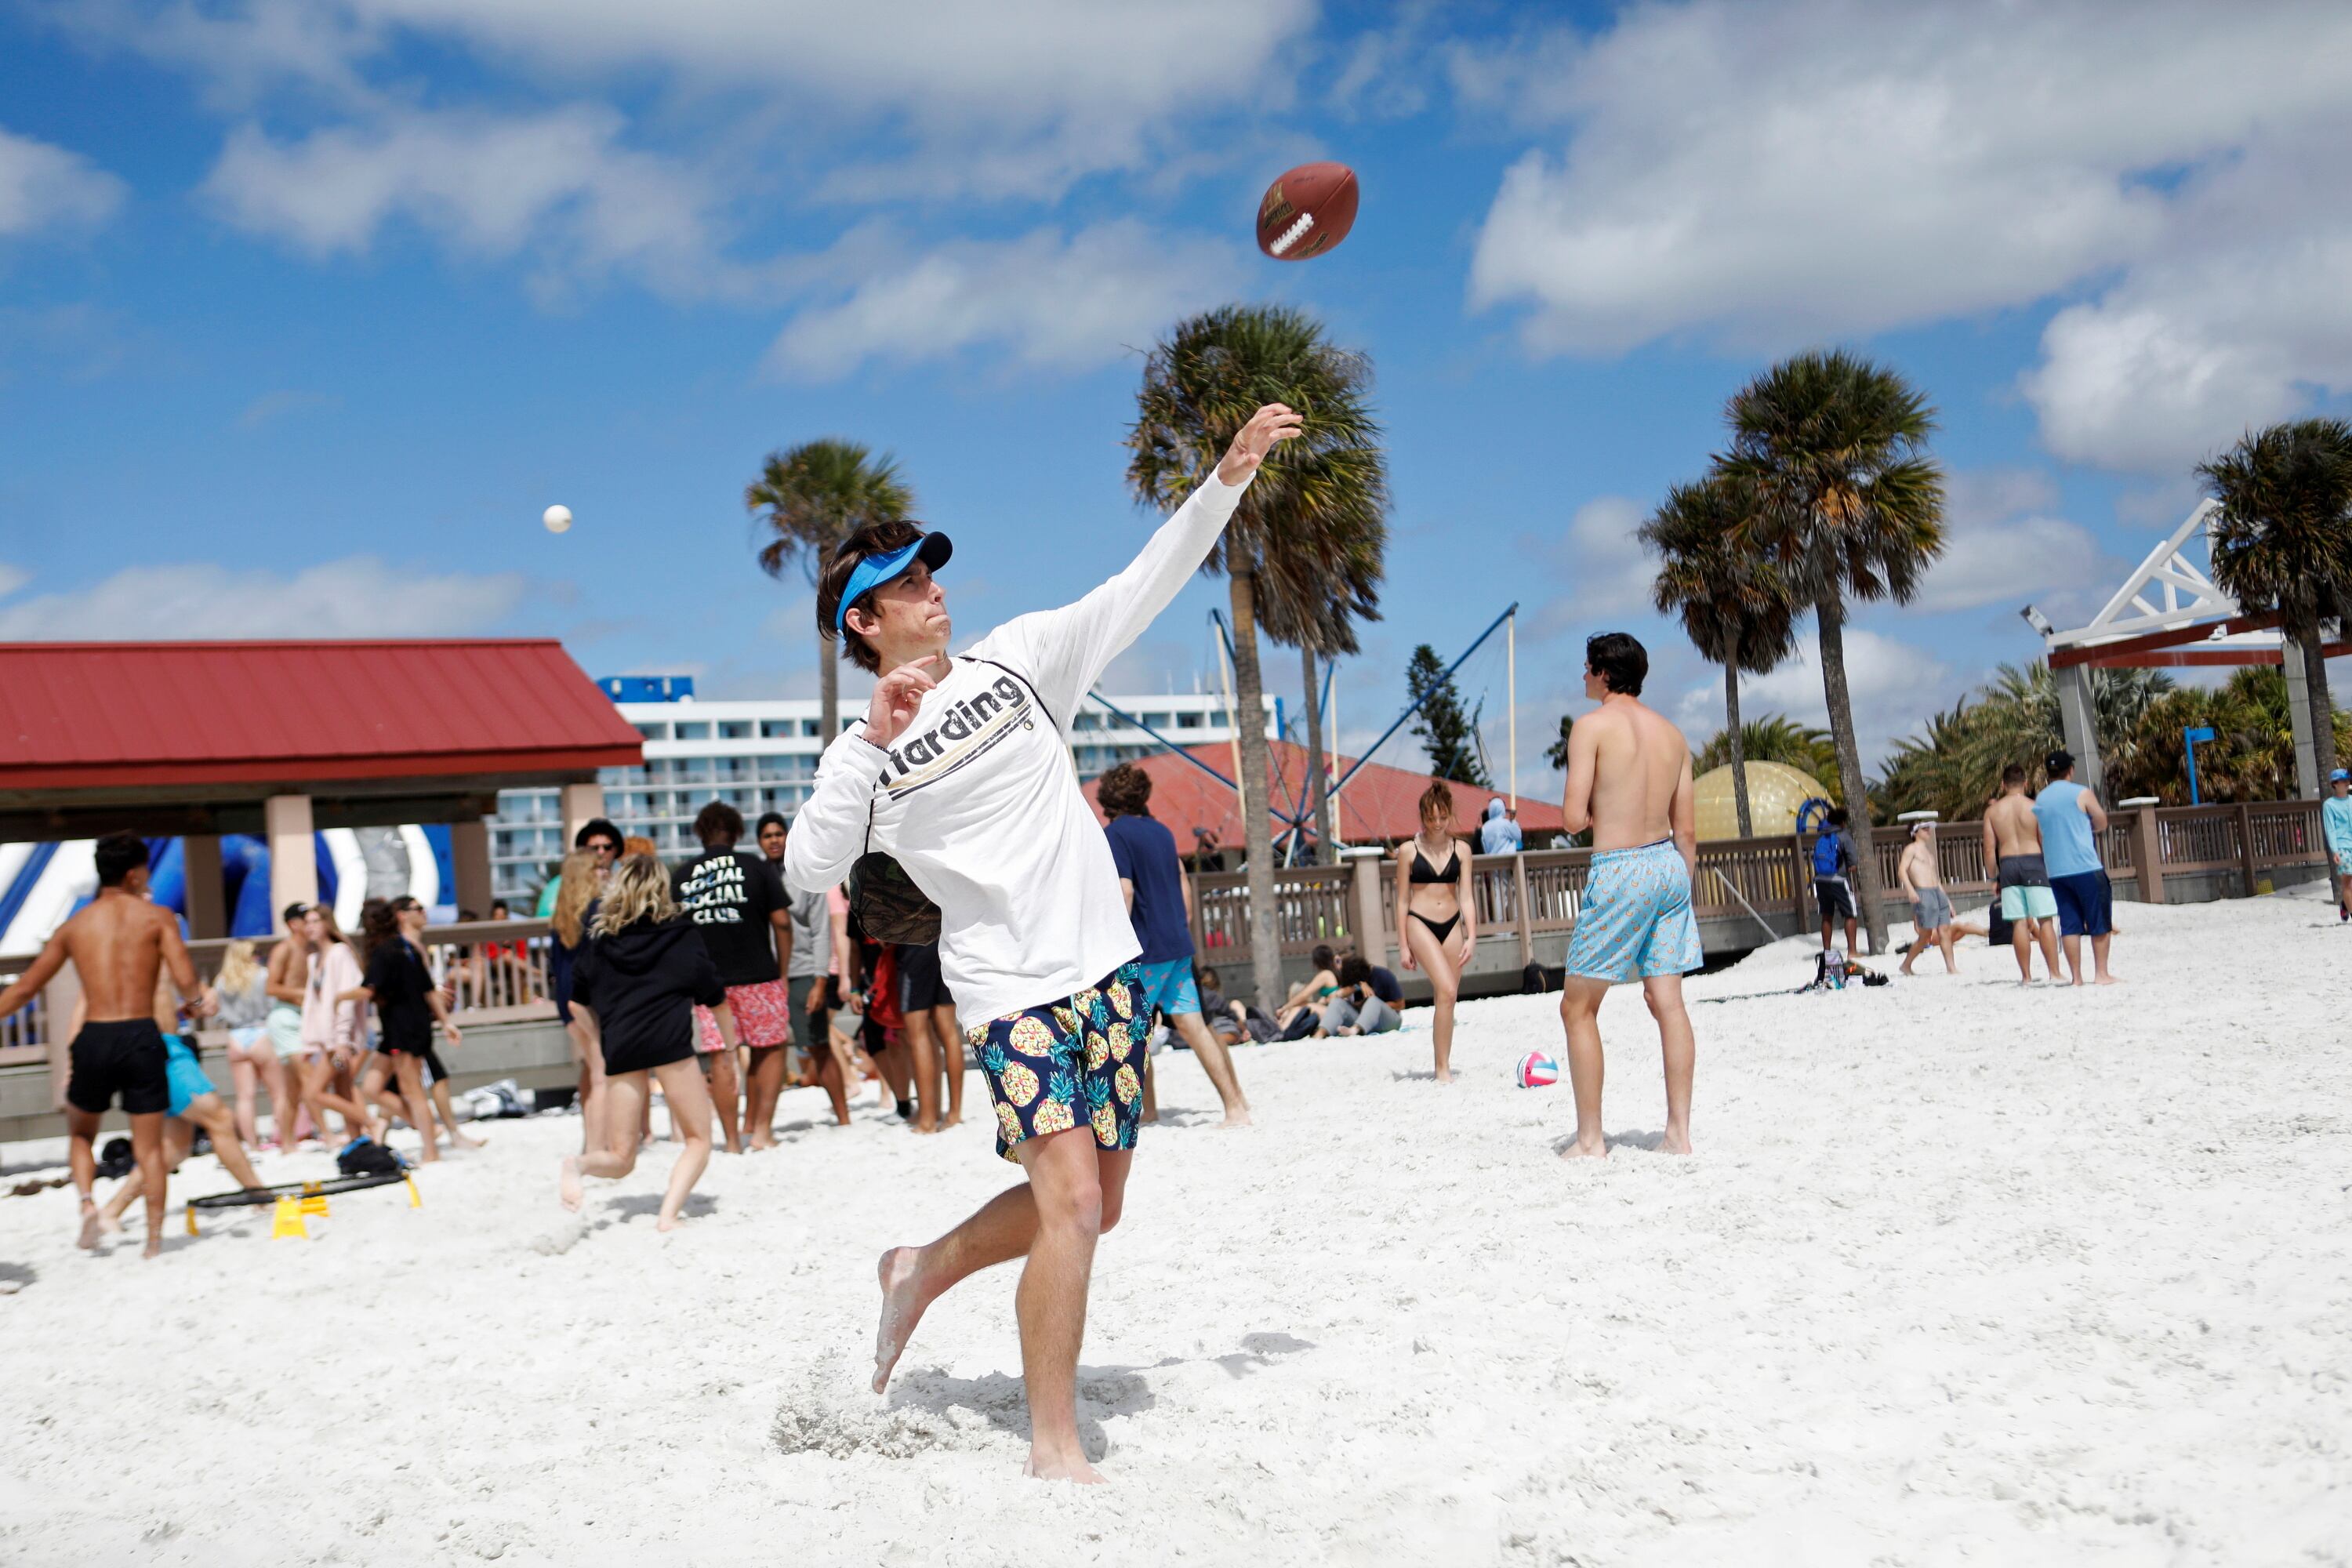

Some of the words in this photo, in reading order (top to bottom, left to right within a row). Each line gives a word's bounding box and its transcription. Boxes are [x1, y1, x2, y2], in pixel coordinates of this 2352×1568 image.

[691, 855, 735, 878] ANTI
[680, 867, 746, 895] SOCIAL
[681, 884, 749, 911] SOCIAL
[692, 907, 743, 925] CLUB
